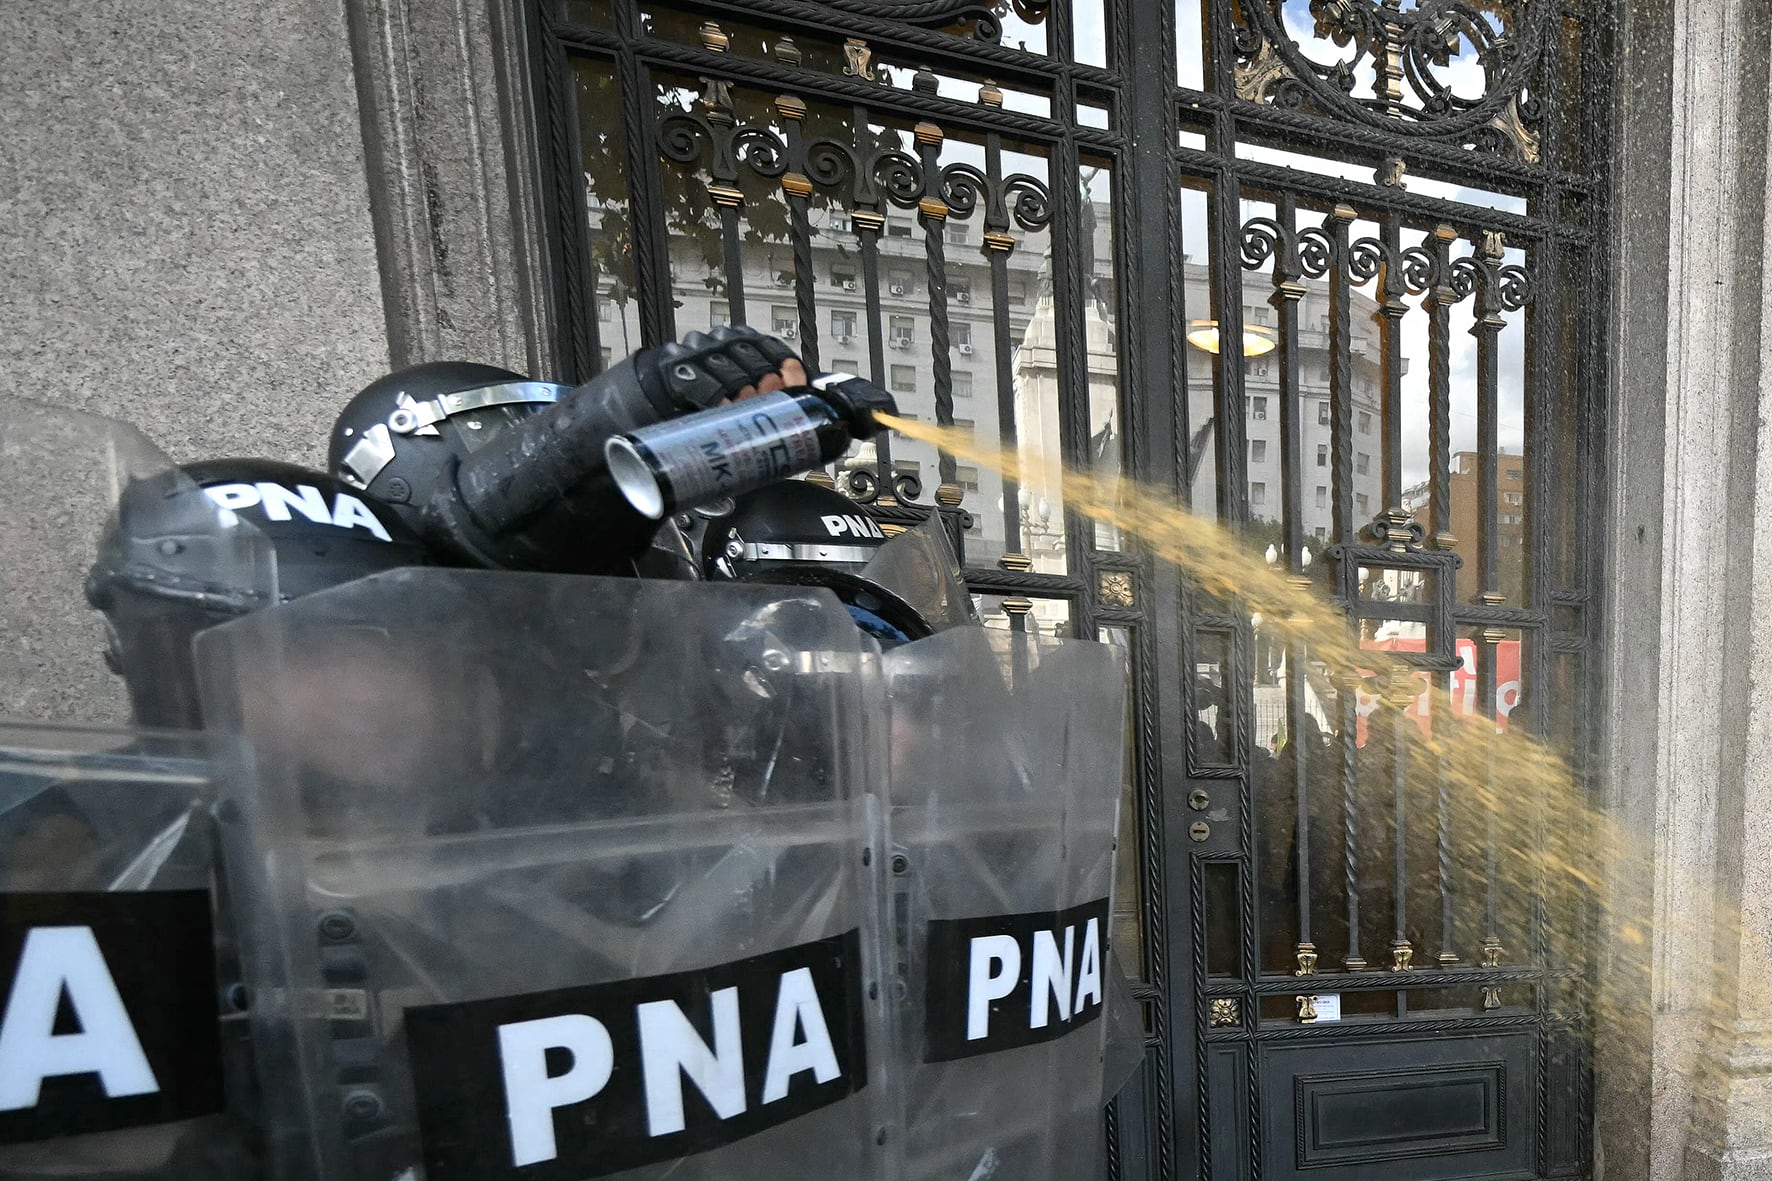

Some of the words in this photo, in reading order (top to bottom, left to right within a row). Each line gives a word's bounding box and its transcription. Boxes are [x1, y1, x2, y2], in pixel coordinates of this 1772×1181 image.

[202, 482, 393, 542] PNA
[821, 515, 883, 539] PNA
[966, 916, 1101, 1041] PNA
[495, 966, 841, 1168] PNA
